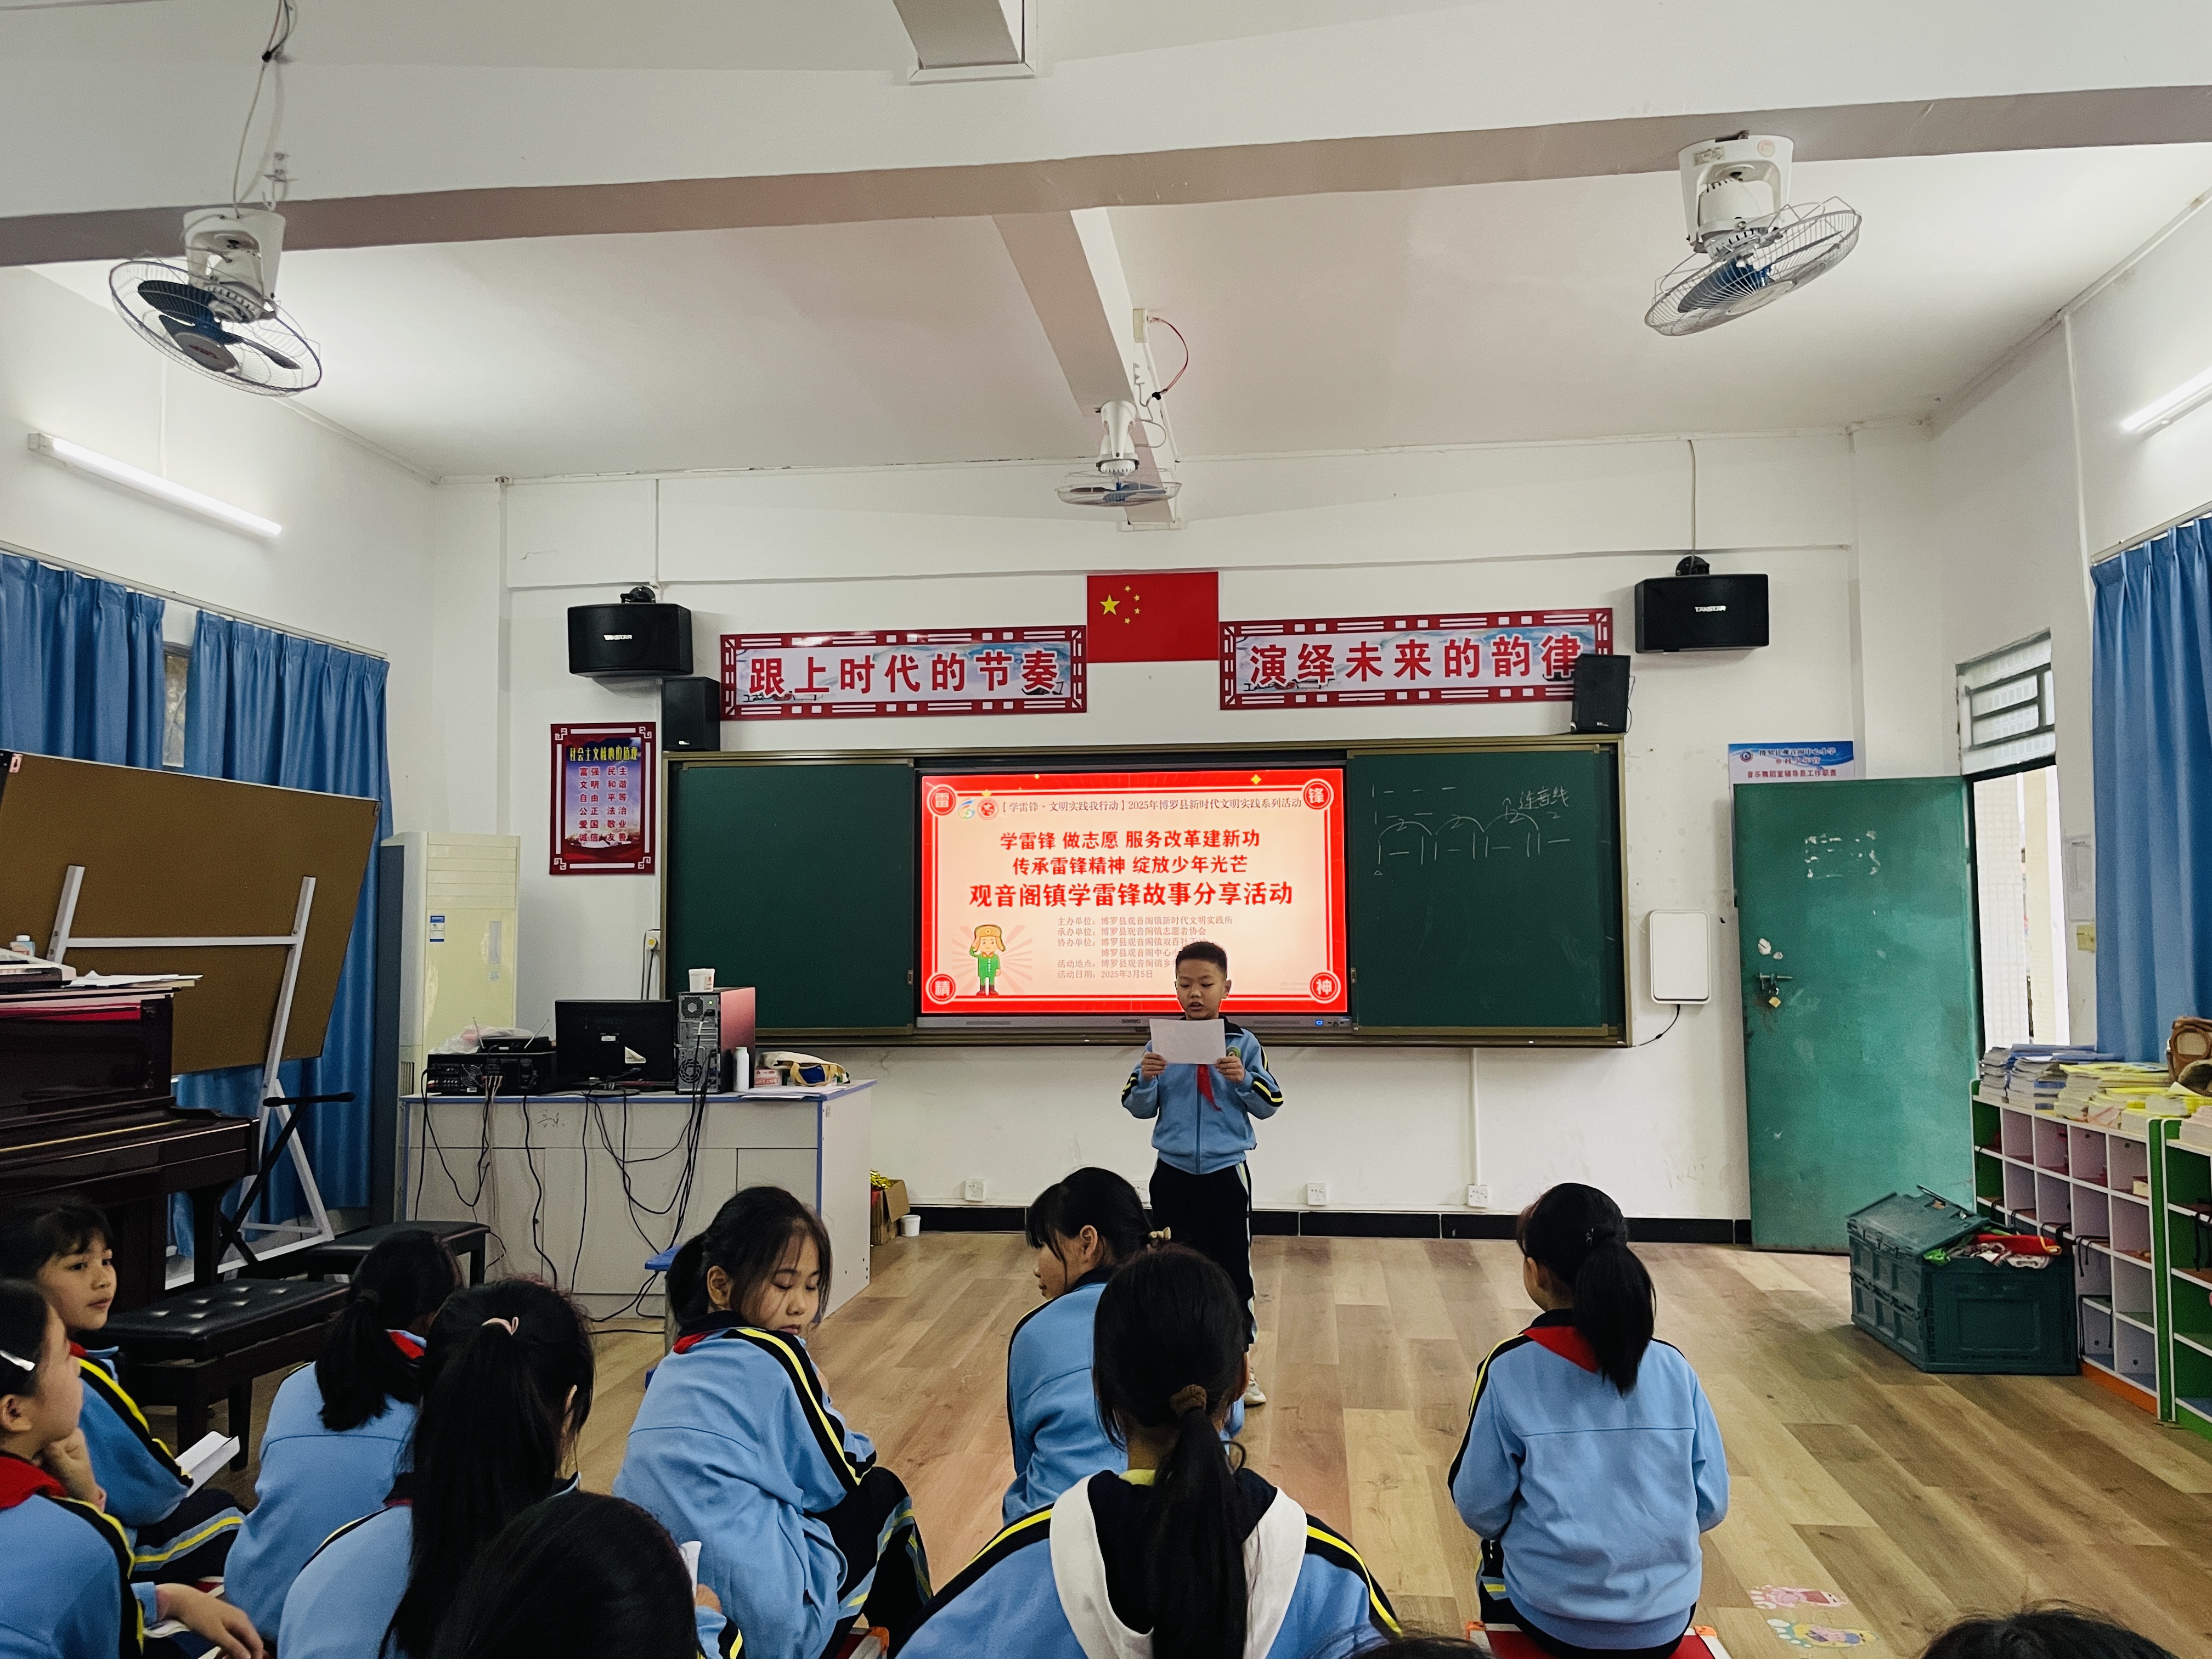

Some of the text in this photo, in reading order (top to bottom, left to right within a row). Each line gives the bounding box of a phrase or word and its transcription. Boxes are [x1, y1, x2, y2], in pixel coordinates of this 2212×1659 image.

[1250, 634, 1581, 685] 演绎未来的韵律
[748, 650, 1058, 695] 跟上时代的节奏
[934, 793, 950, 808] 雷
[1308, 788, 1324, 804] 锋
[1518, 786, 1570, 810] 连音线
[1000, 829, 1260, 850] 学雷锋 做志愿 服务改革建新功
[1012, 854, 1248, 876] 传承雷锋精神 绽放少年光芒
[969, 881, 1293, 907] 观音阁镇学雷锋故事分享活动
[935, 981, 950, 996] 精
[1316, 979, 1332, 995] 神
